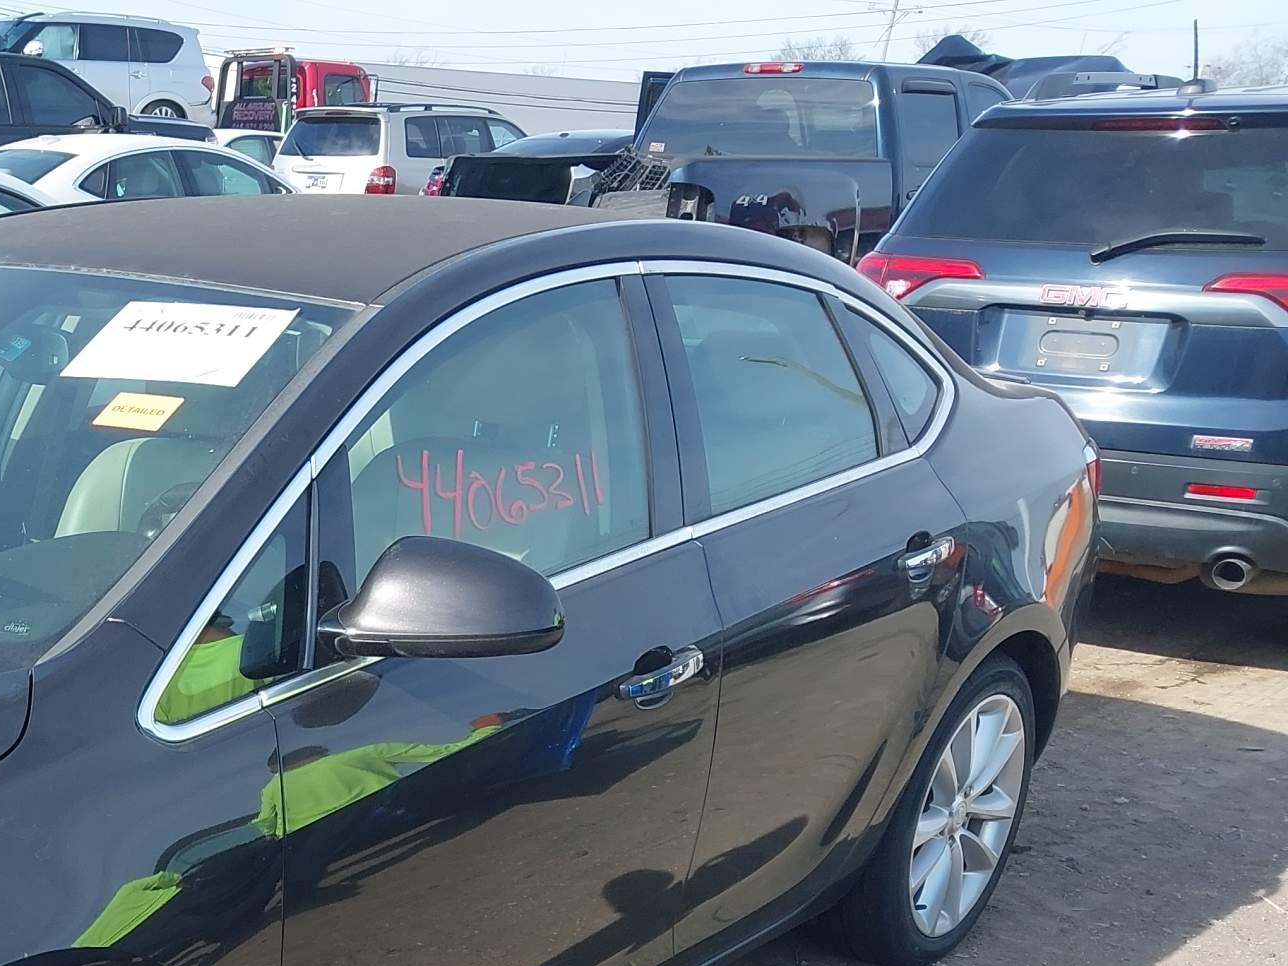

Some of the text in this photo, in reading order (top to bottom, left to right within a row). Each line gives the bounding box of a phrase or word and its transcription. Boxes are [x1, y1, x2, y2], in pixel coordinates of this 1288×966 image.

[232, 110, 275, 120] RECOVERY
[1040, 283, 1129, 310] GMC
[122, 318, 259, 338] 44065311
[111, 404, 166, 416] DETAILED
[396, 449, 604, 537] 44065311
